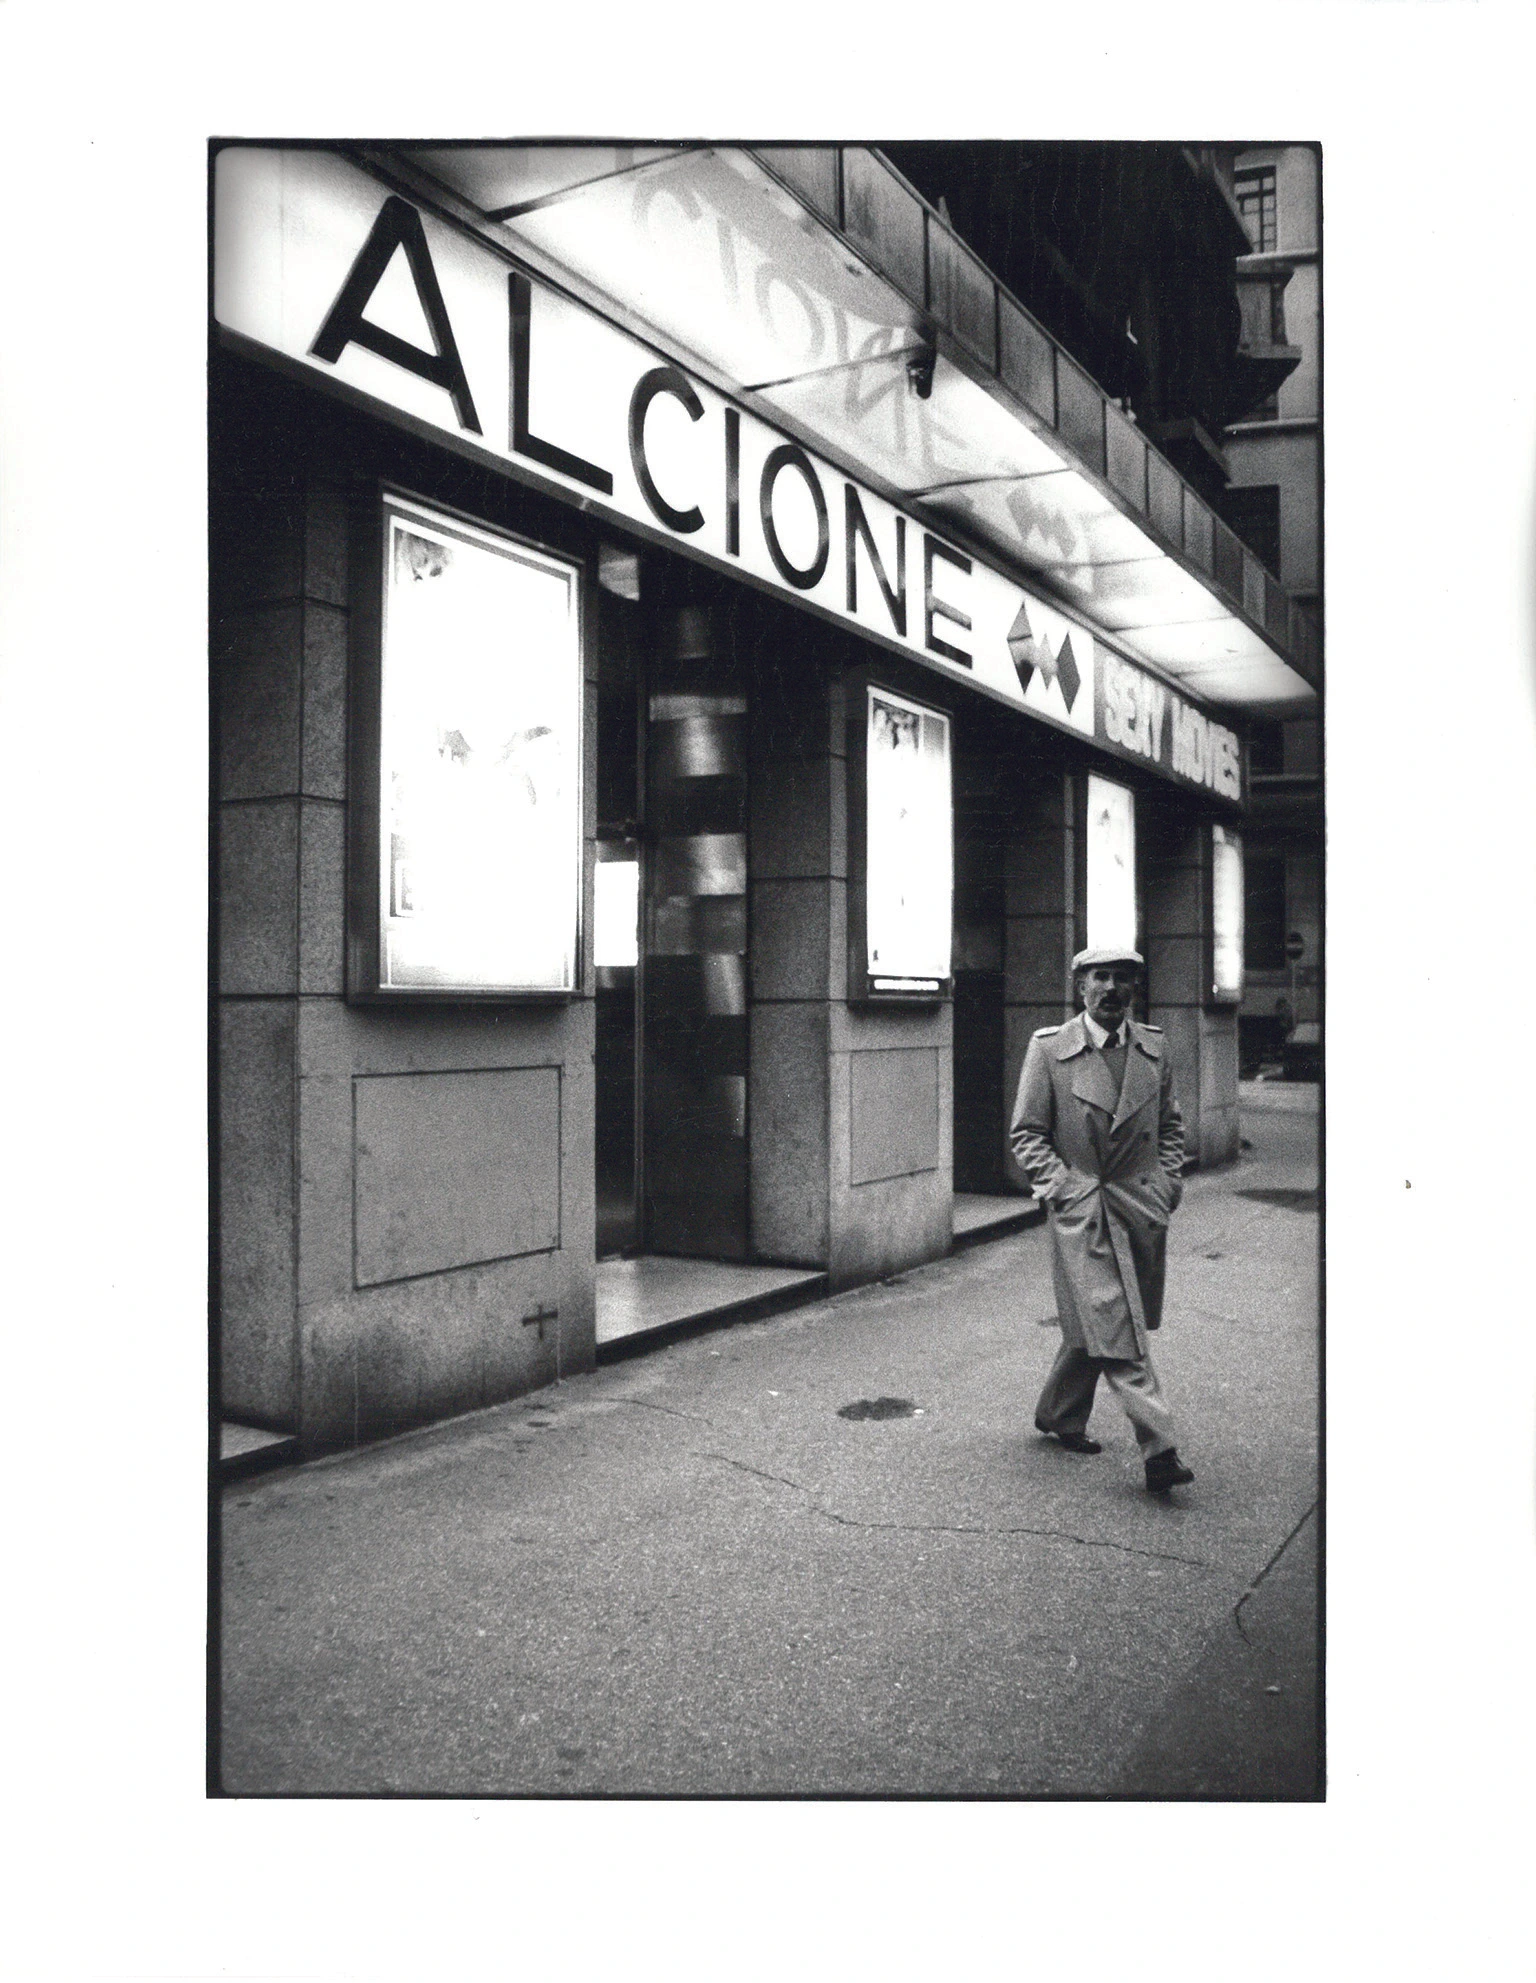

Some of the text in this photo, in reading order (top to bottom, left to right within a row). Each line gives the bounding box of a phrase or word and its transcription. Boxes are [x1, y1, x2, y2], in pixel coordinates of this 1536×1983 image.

[306, 195, 974, 669] ALCIONE
[1103, 655, 1241, 801] SEXY MOVIES
